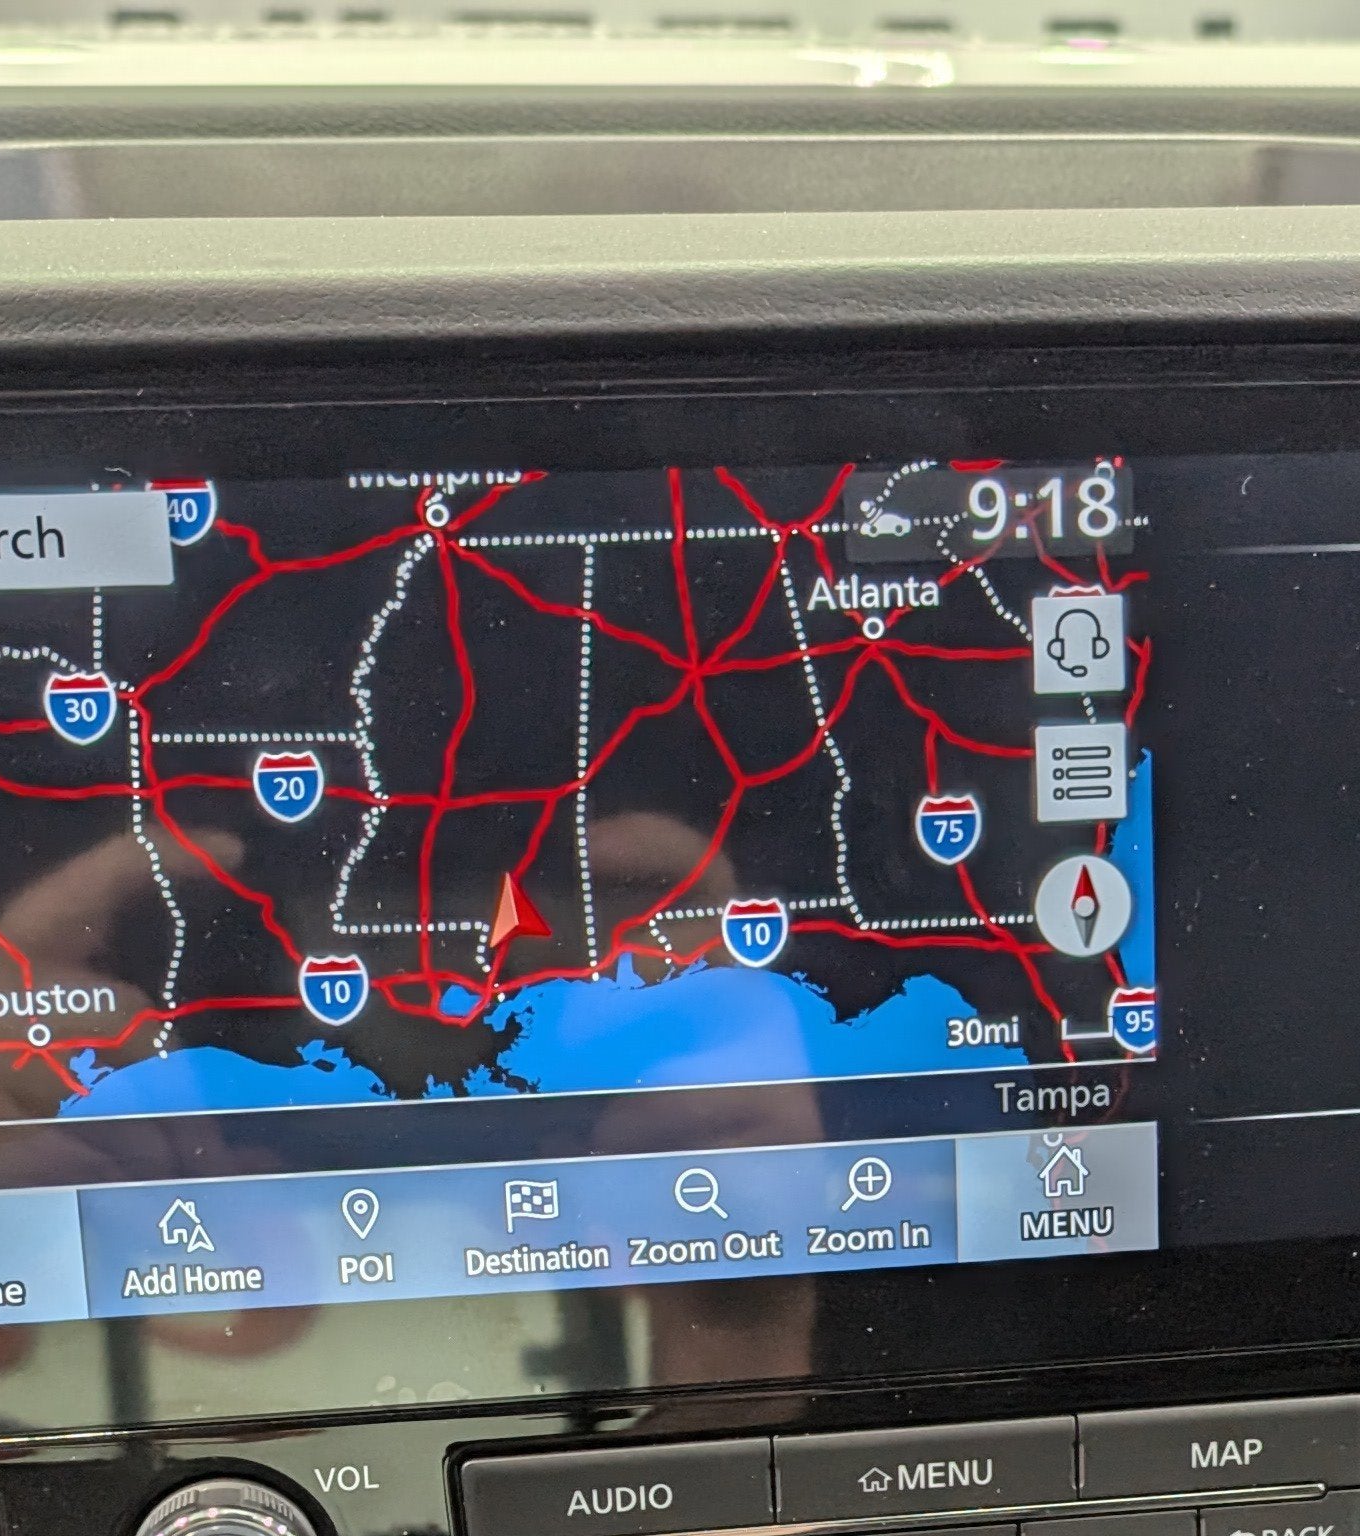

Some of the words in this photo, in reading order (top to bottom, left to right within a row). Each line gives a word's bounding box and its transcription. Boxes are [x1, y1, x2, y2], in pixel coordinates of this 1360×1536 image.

[167, 498, 197, 523] 40
[969, 477, 1117, 542] 9:18
[807, 575, 940, 612] Atlanta
[64, 698, 97, 723] 30
[273, 777, 306, 802] 20
[933, 820, 965, 844] 75
[741, 923, 771, 947] 10
[320, 980, 350, 1005] 10
[946, 1016, 1020, 1047] 30mi
[1125, 1009, 1155, 1033] 95
[994, 1081, 1110, 1115] Tampa
[809, 1226, 895, 1254] Zoom
[902, 1223, 930, 1249] In
[1021, 1208, 1114, 1240] MENU
[467, 1242, 609, 1275] Destination
[629, 1239, 717, 1266] Zoom
[724, 1231, 782, 1259] Out
[123, 1267, 178, 1297] Add
[185, 1265, 263, 1293] Home
[340, 1254, 394, 1284] POI
[1190, 1439, 1263, 1469] MAP
[314, 1465, 380, 1493] VOL
[897, 1459, 993, 1491] MENU
[567, 1483, 673, 1516] AUDIO
